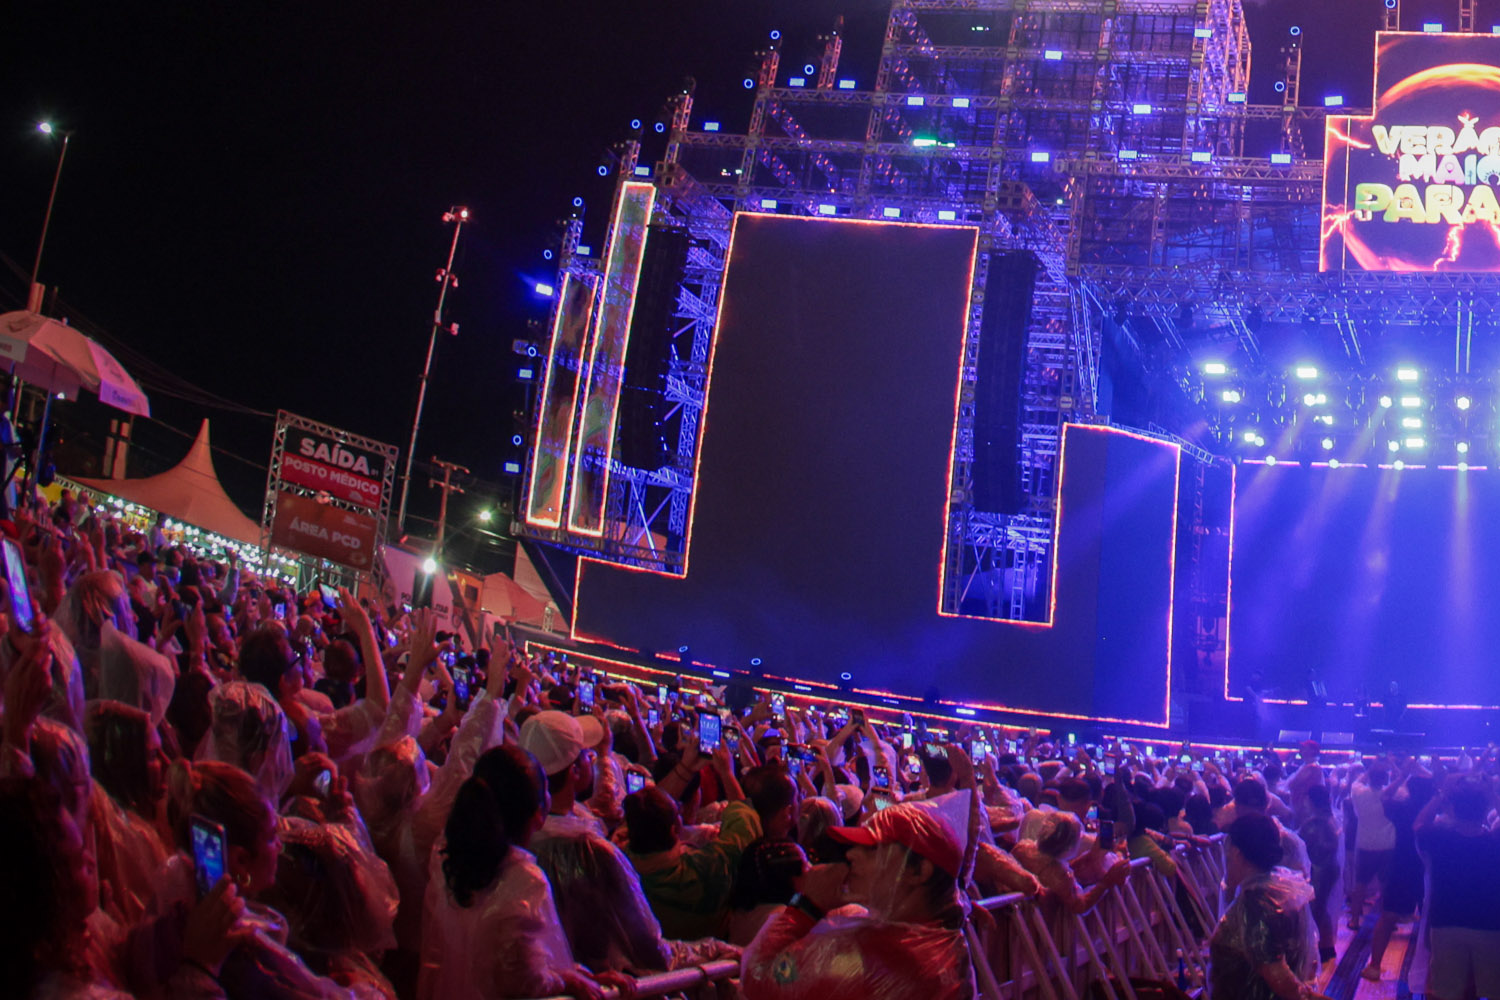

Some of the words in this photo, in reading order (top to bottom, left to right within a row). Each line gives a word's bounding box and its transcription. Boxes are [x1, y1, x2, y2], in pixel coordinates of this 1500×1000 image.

[285, 456, 327, 478] POSTO
[329, 471, 380, 495] MÉDICO
[299, 437, 370, 476] SAÍDA
[289, 516, 328, 540] ÁREA
[332, 531, 361, 549] PCD
